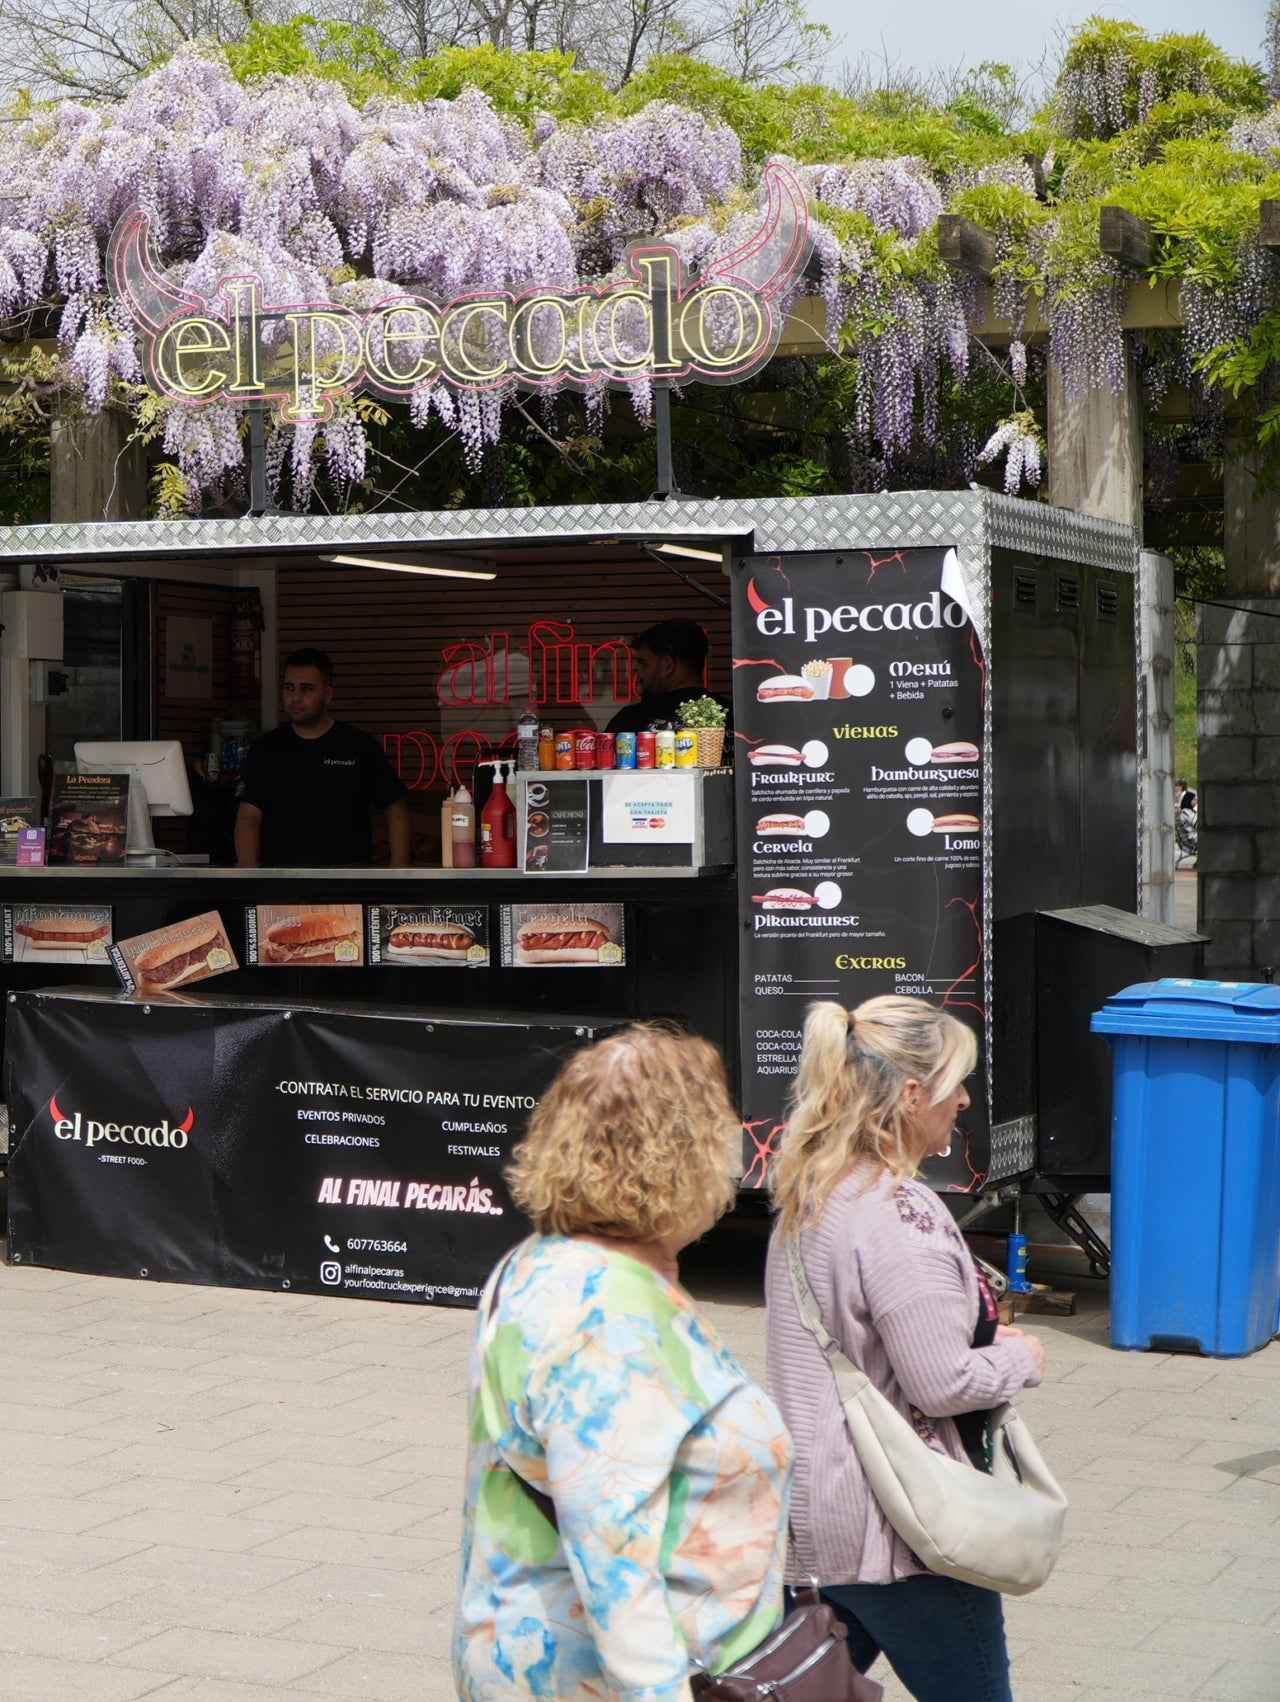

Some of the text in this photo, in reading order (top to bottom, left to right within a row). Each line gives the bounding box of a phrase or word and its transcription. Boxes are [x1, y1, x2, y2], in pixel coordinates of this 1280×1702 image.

[157, 257, 763, 413] el pecado
[756, 591, 968, 642] el pecado
[889, 681, 895, 689] 1
[896, 680, 919, 689] Viena
[927, 678, 959, 688] Patatas
[896, 690, 924, 700] Bebida
[66, 776, 112, 784] La Pecadora
[751, 771, 835, 787] Frankfurt
[753, 839, 813, 854] Cervela
[944, 834, 980, 851] Lomo
[3, 908, 12, 936] PICANT
[849, 931, 865, 939] mayor
[249, 944, 257, 963] 100%
[372, 944, 381, 963] 100%
[504, 948, 513, 965] 100%
[755, 973, 793, 983] PATATAS
[895, 973, 925, 982] BACON
[755, 986, 784, 995] QUESO
[895, 986, 933, 995] CEBOLLA
[756, 1030, 802, 1039] COCA-COLA
[756, 1042, 803, 1051] COCA-COLA
[757, 1054, 797, 1063] ESTRELLA
[757, 1065, 798, 1075] AQUARIUS
[350, 1086, 364, 1099] EL
[366, 1087, 423, 1104] SERVICIO
[426, 1091, 460, 1106] PARA
[463, 1093, 480, 1107] TU
[297, 1110, 386, 1126] EVENTOS PRIVADOS
[54, 1112, 188, 1149] el pecado
[441, 1121, 508, 1134] CUMPLEAÑOS
[305, 1133, 380, 1148] CELEBRACIONES
[447, 1144, 500, 1157] FESTIVALES
[317, 1177, 342, 1204] AL
[346, 1179, 401, 1207] FINAL
[347, 1238, 408, 1253] 607763664
[344, 1264, 405, 1278] alfinalpecaras
